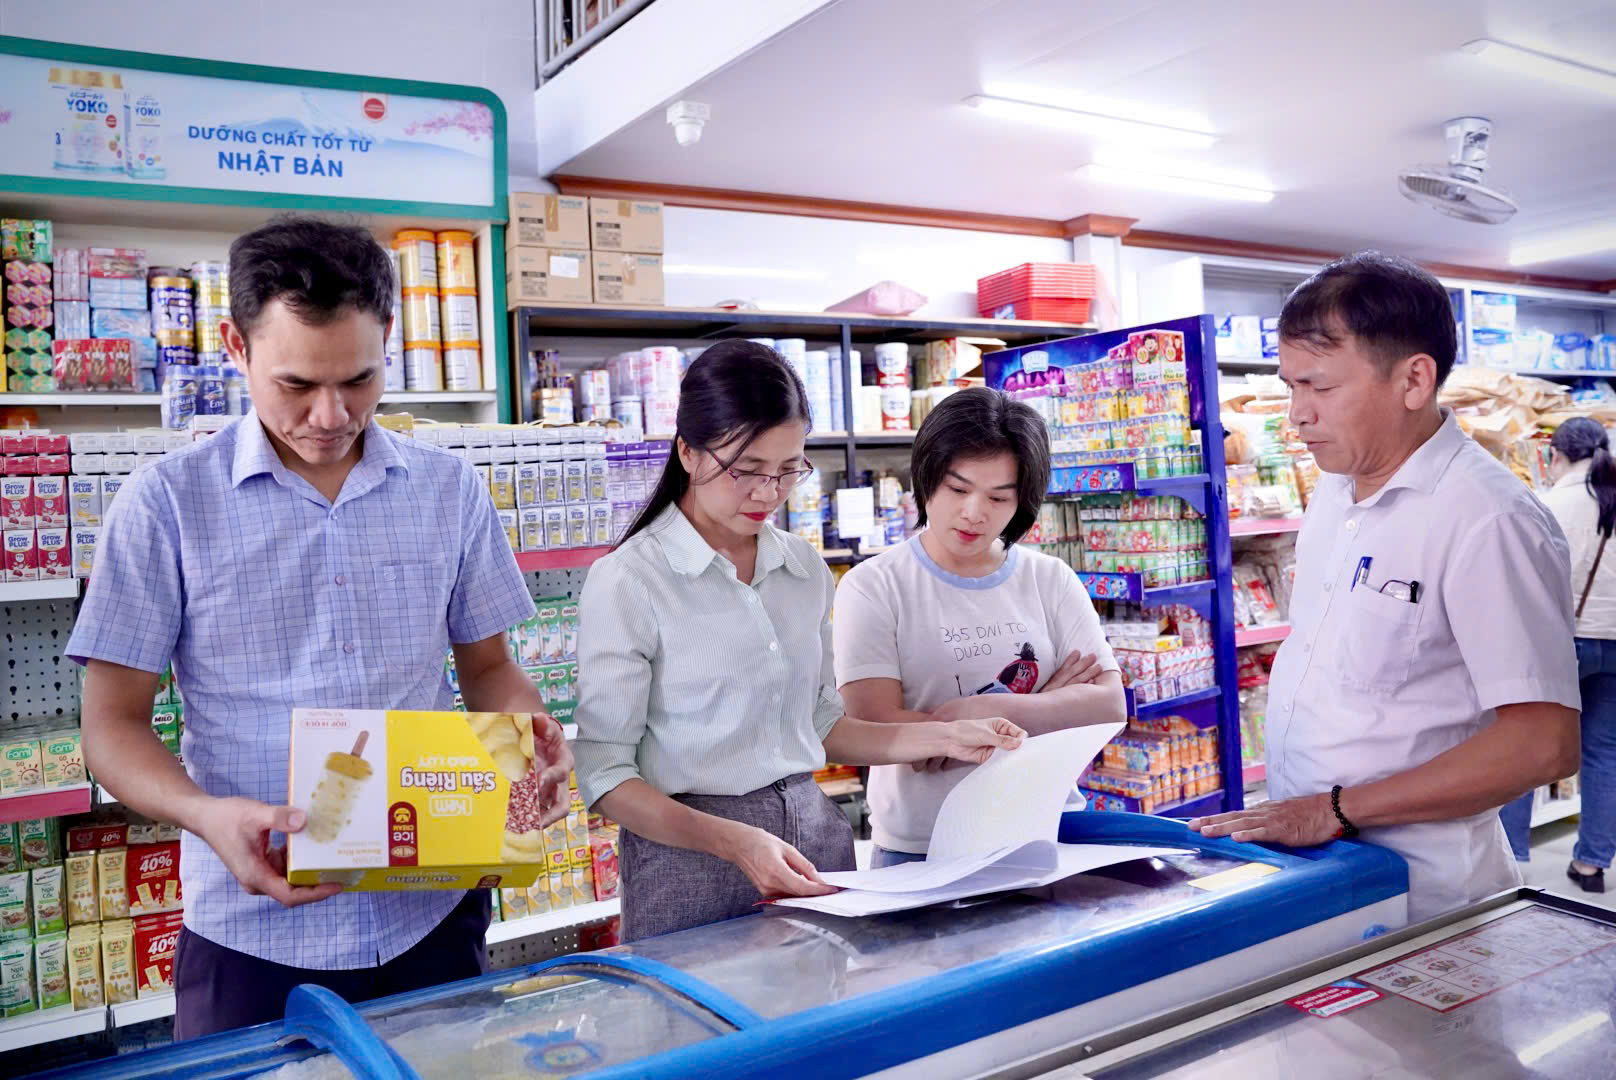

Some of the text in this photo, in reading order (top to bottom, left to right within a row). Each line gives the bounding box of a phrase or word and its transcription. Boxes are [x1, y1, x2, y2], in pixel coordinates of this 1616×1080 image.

[66, 97, 109, 114] YOKO
[135, 106, 160, 117] YOKO
[188, 124, 372, 153] DƯỠNG CHẤT TỐT TỪ
[218, 150, 343, 178] NHẬT BẢN
[940, 626, 970, 643] 365
[1006, 622, 1028, 634] TO
[400, 766, 457, 792] Riêng
[435, 799, 465, 814] Kem
[393, 832, 414, 844] ice
[139, 854, 172, 872] 40%
[148, 935, 179, 954] 40%
